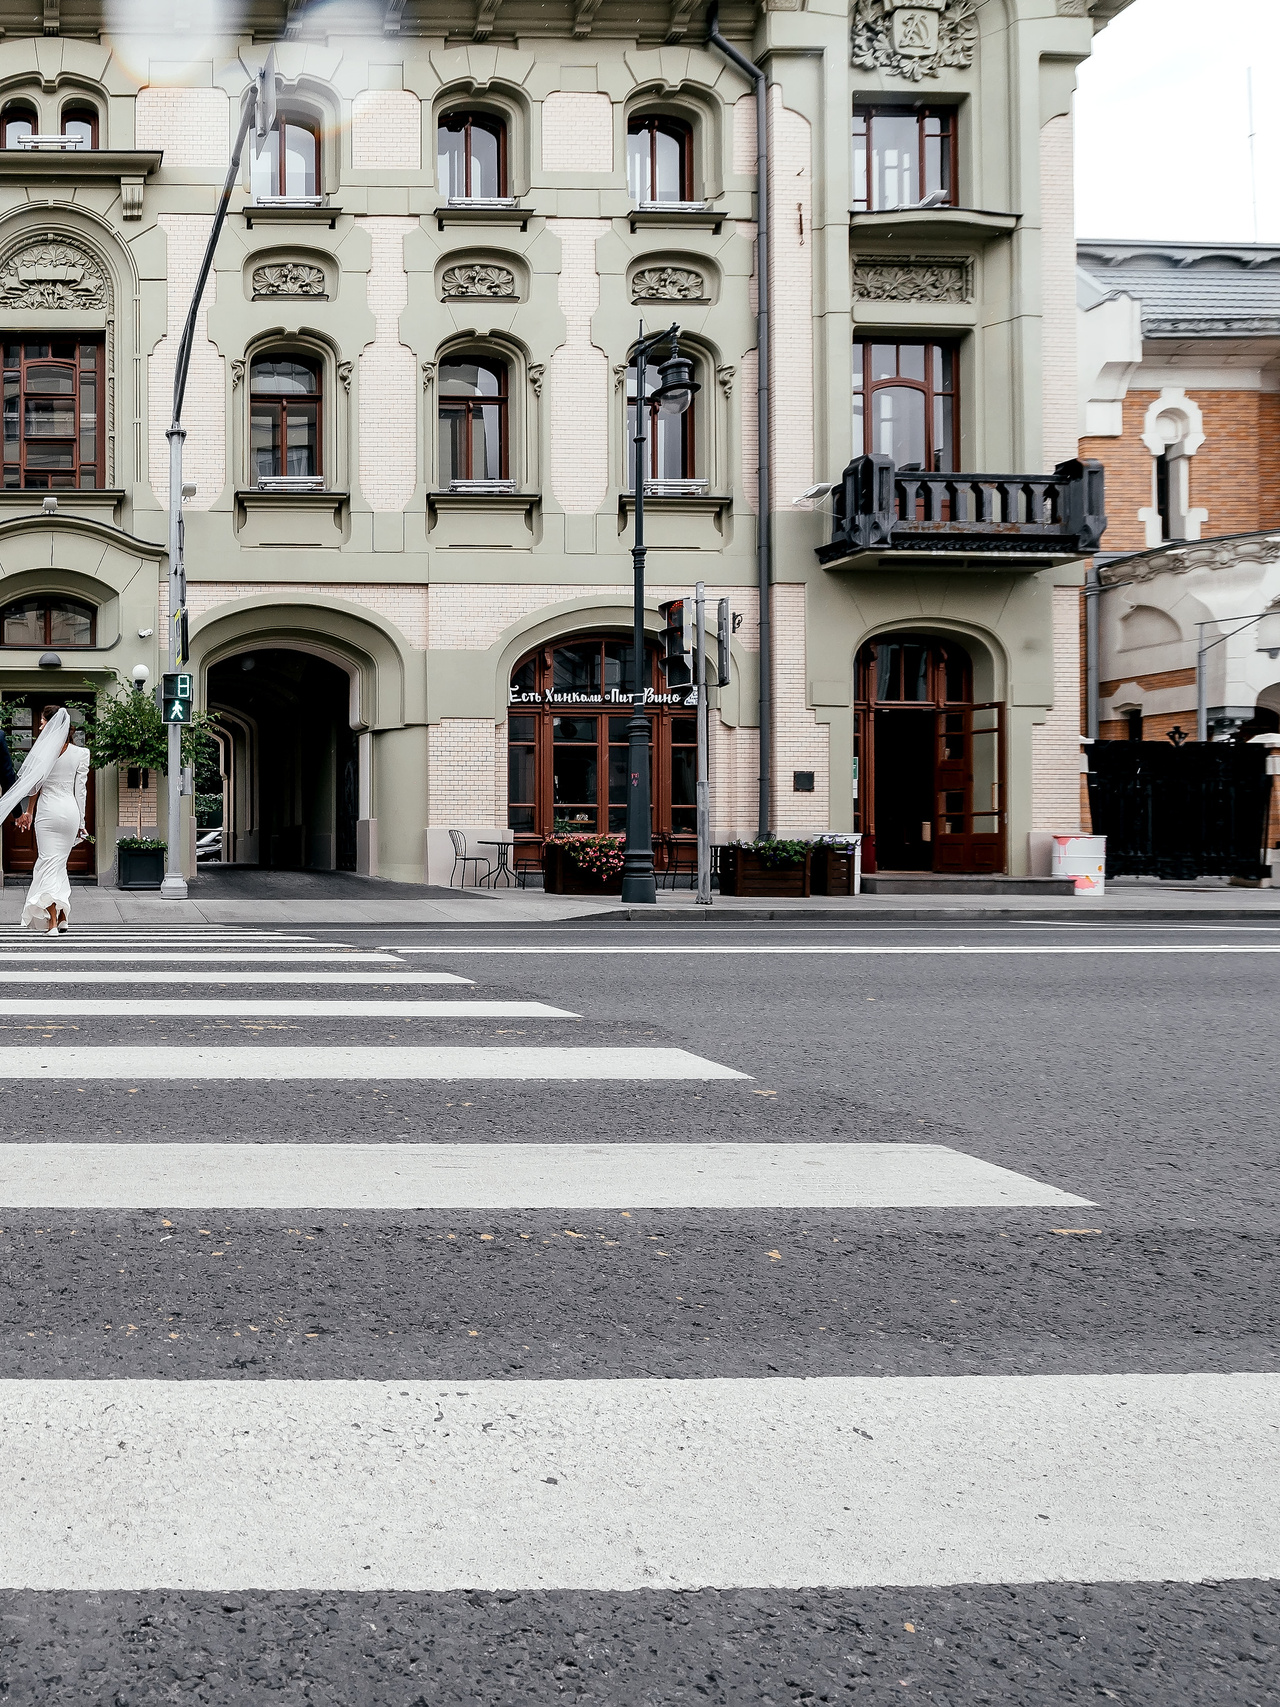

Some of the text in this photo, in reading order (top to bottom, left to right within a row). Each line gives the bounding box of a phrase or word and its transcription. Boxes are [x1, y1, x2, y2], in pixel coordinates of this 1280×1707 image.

[178, 674, 189, 697] 8
[510, 684, 542, 703] Есть
[545, 687, 604, 703] Хинкали
[611, 688, 638, 704] Пит
[644, 687, 681, 704] Вино
